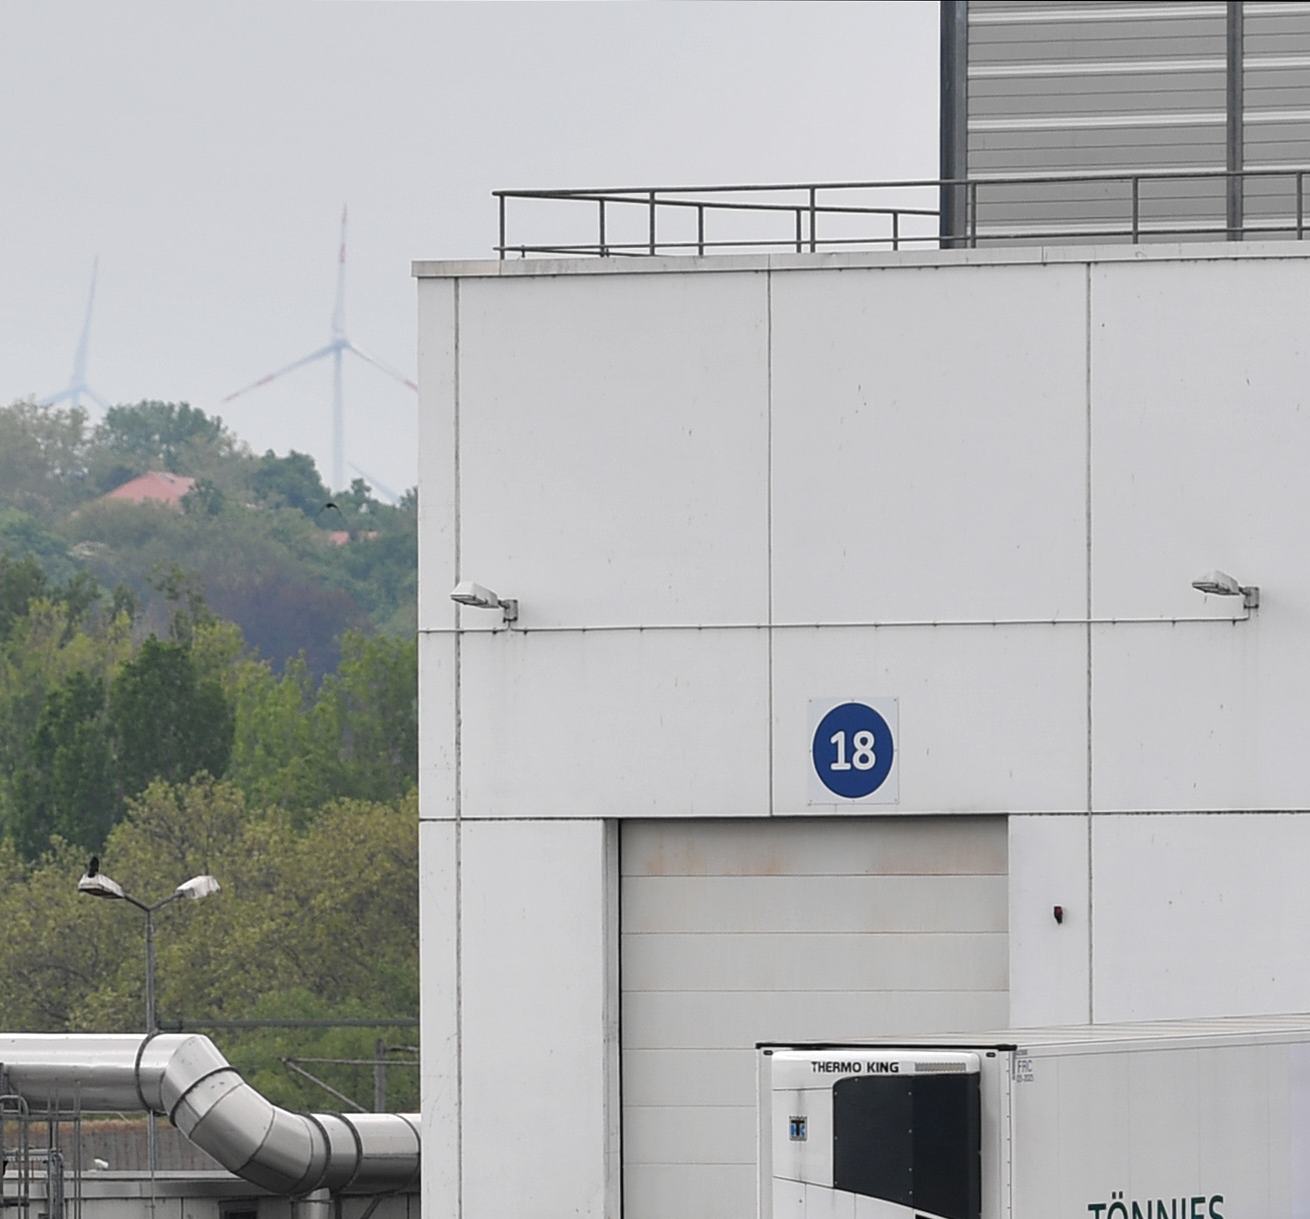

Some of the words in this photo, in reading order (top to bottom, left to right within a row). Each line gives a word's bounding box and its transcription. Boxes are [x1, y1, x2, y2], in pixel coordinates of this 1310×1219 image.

[830, 730, 877, 771] 18
[811, 1061, 862, 1073] THERMO
[866, 1061, 899, 1073] KING
